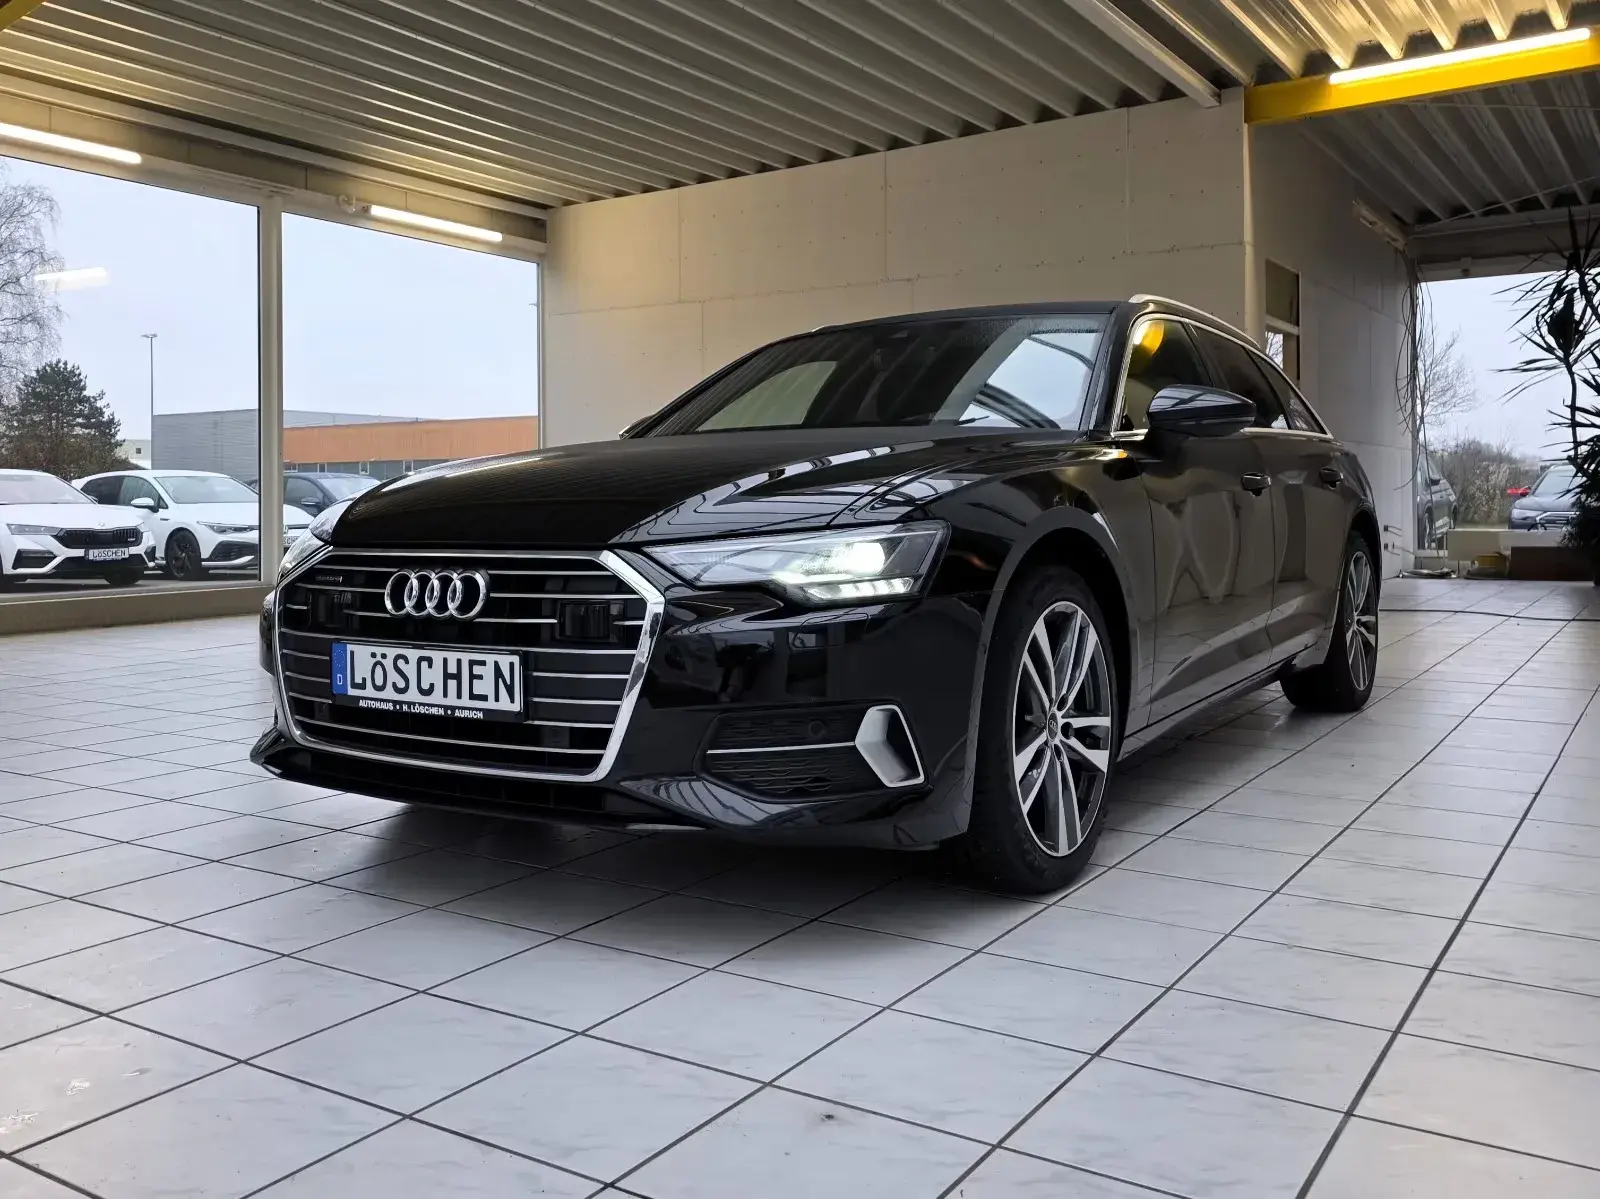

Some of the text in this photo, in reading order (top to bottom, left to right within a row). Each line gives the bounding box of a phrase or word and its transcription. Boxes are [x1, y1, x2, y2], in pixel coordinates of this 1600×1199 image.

[337, 650, 515, 704] D LÖSCHEN
[359, 700, 394, 710] AUTOHAUS
[454, 709, 484, 719] AURICH
